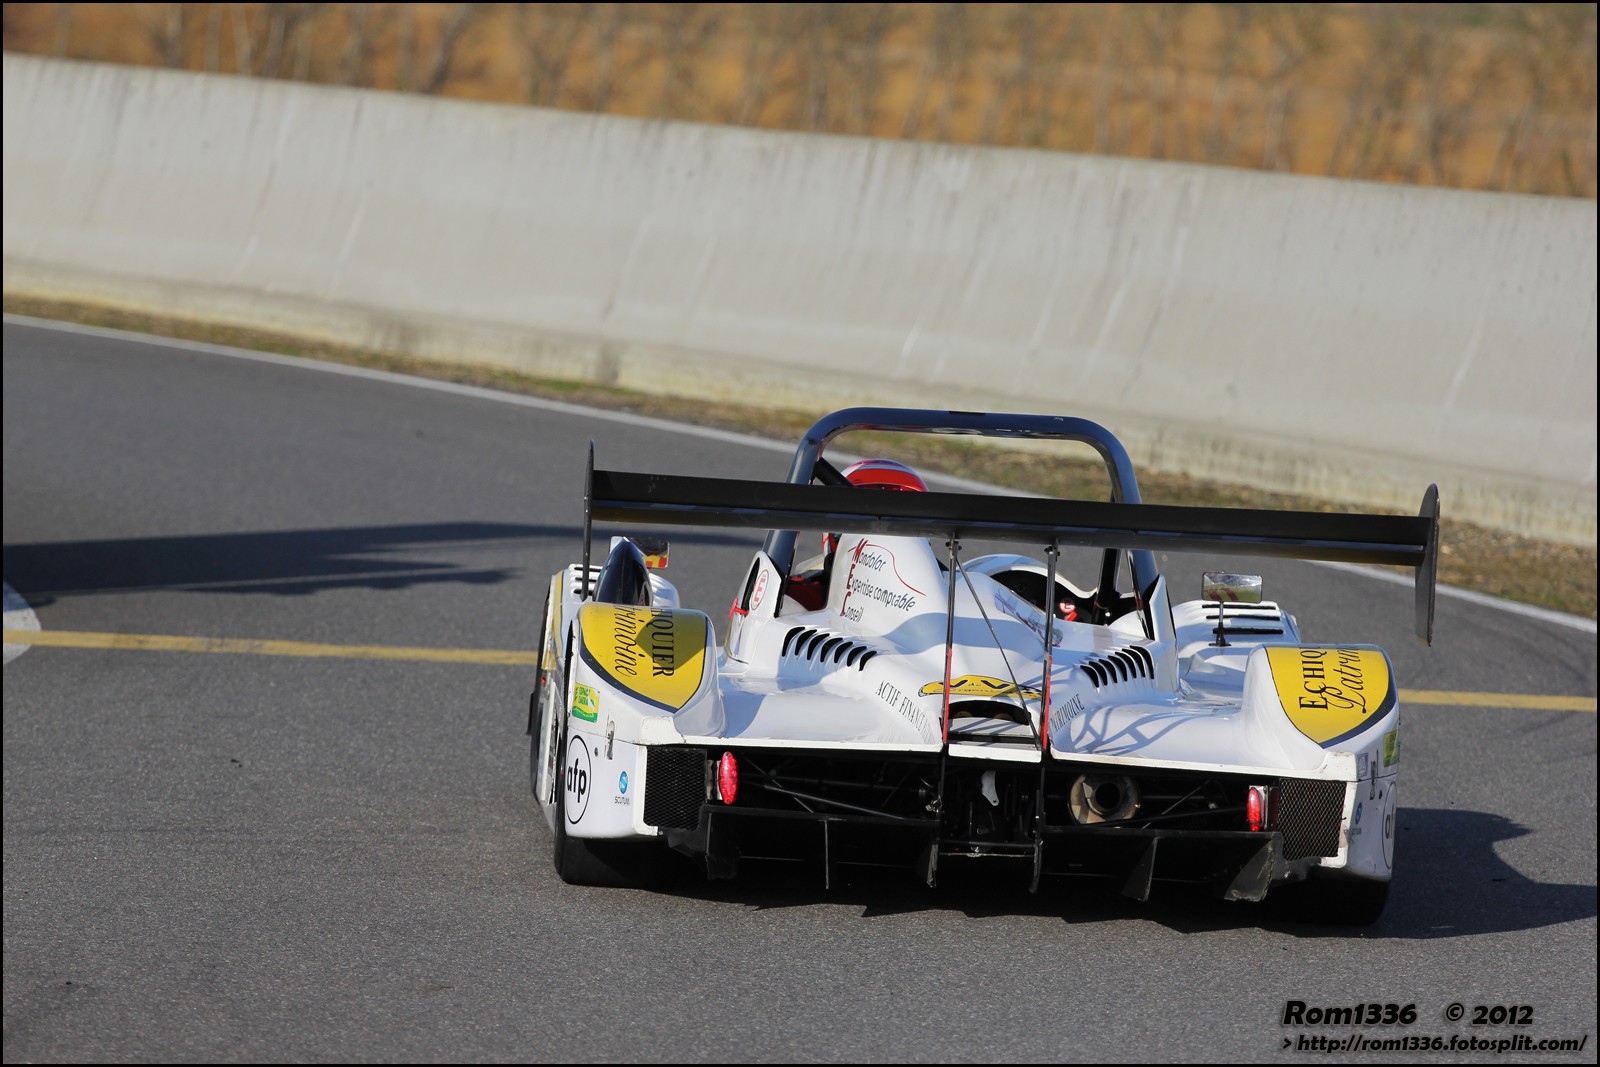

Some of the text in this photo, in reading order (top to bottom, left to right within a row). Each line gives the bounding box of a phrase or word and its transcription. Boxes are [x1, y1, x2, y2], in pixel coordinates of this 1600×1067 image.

[874, 586, 916, 612] comptable
[875, 680, 901, 707] ACTIF
[1299, 647, 1328, 711] ECHIQ
[566, 758, 587, 804] afp
